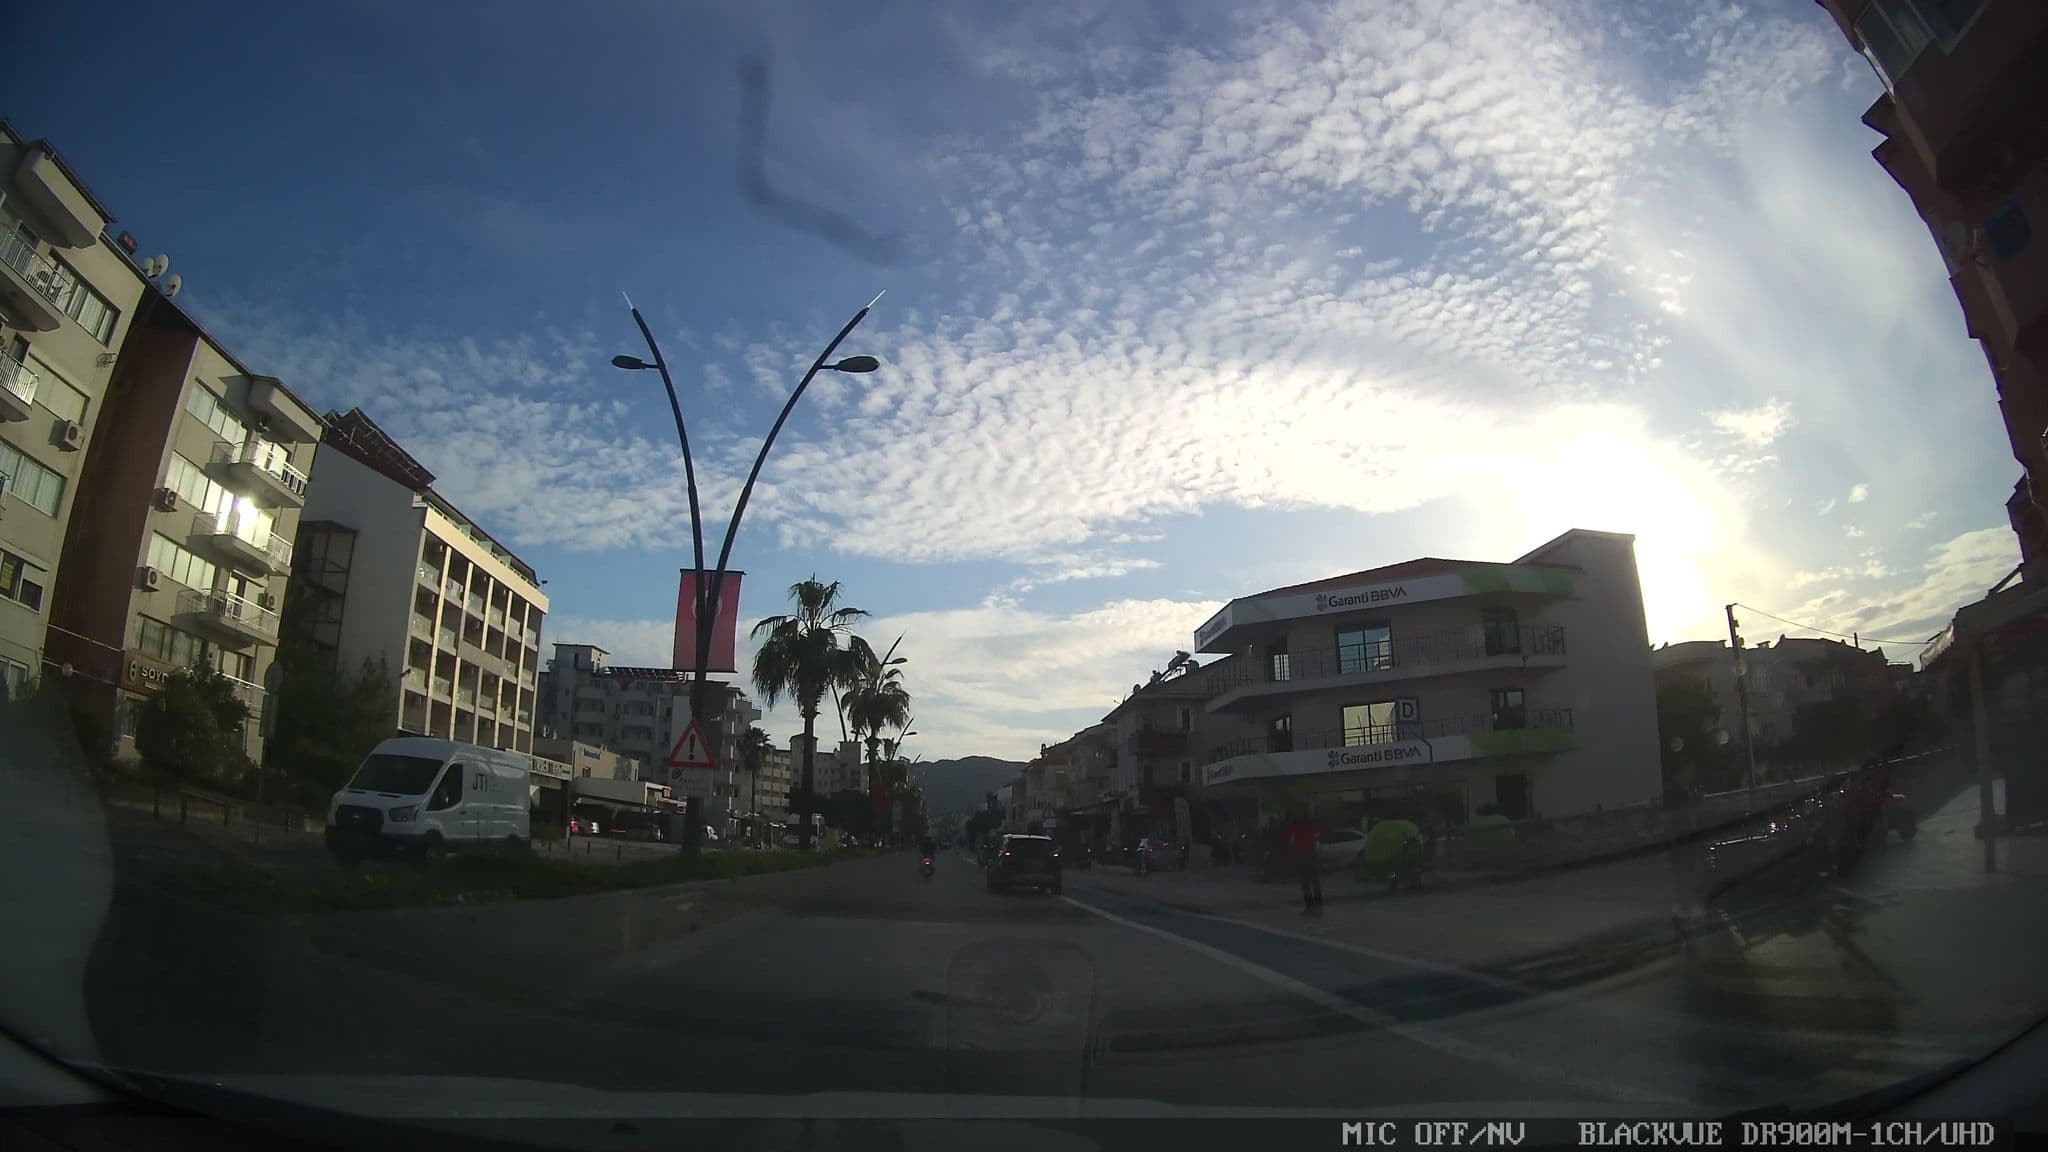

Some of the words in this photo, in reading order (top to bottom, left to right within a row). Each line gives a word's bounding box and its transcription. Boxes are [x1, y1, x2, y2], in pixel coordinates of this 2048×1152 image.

[1329, 592, 1368, 607] Garanti
[1371, 586, 1407, 602] BBVA
[1402, 702, 1414, 718] D
[1341, 752, 1381, 765] Garanti
[1384, 746, 1421, 761] BBVA
[472, 773, 488, 791] JTI
